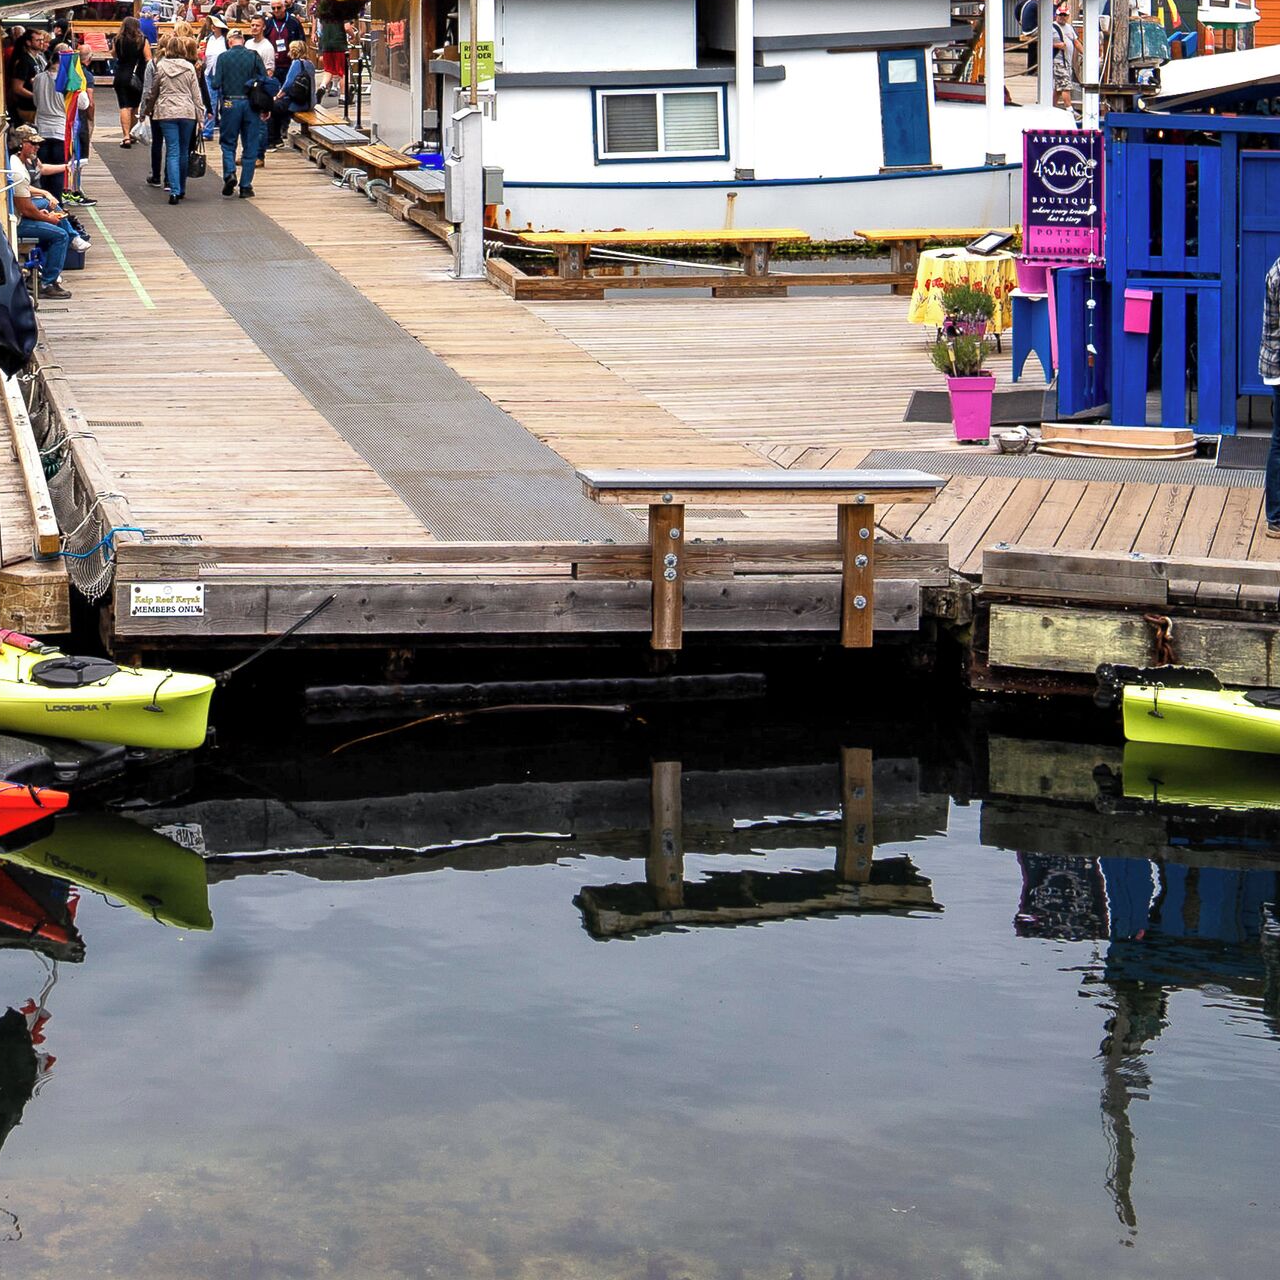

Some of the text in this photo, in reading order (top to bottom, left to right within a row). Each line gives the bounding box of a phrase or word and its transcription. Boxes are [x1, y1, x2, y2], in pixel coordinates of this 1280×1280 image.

[1032, 197, 1095, 205] BOUTIQUE
[155, 596, 175, 604] Reef
[178, 605, 201, 613] ONLY
